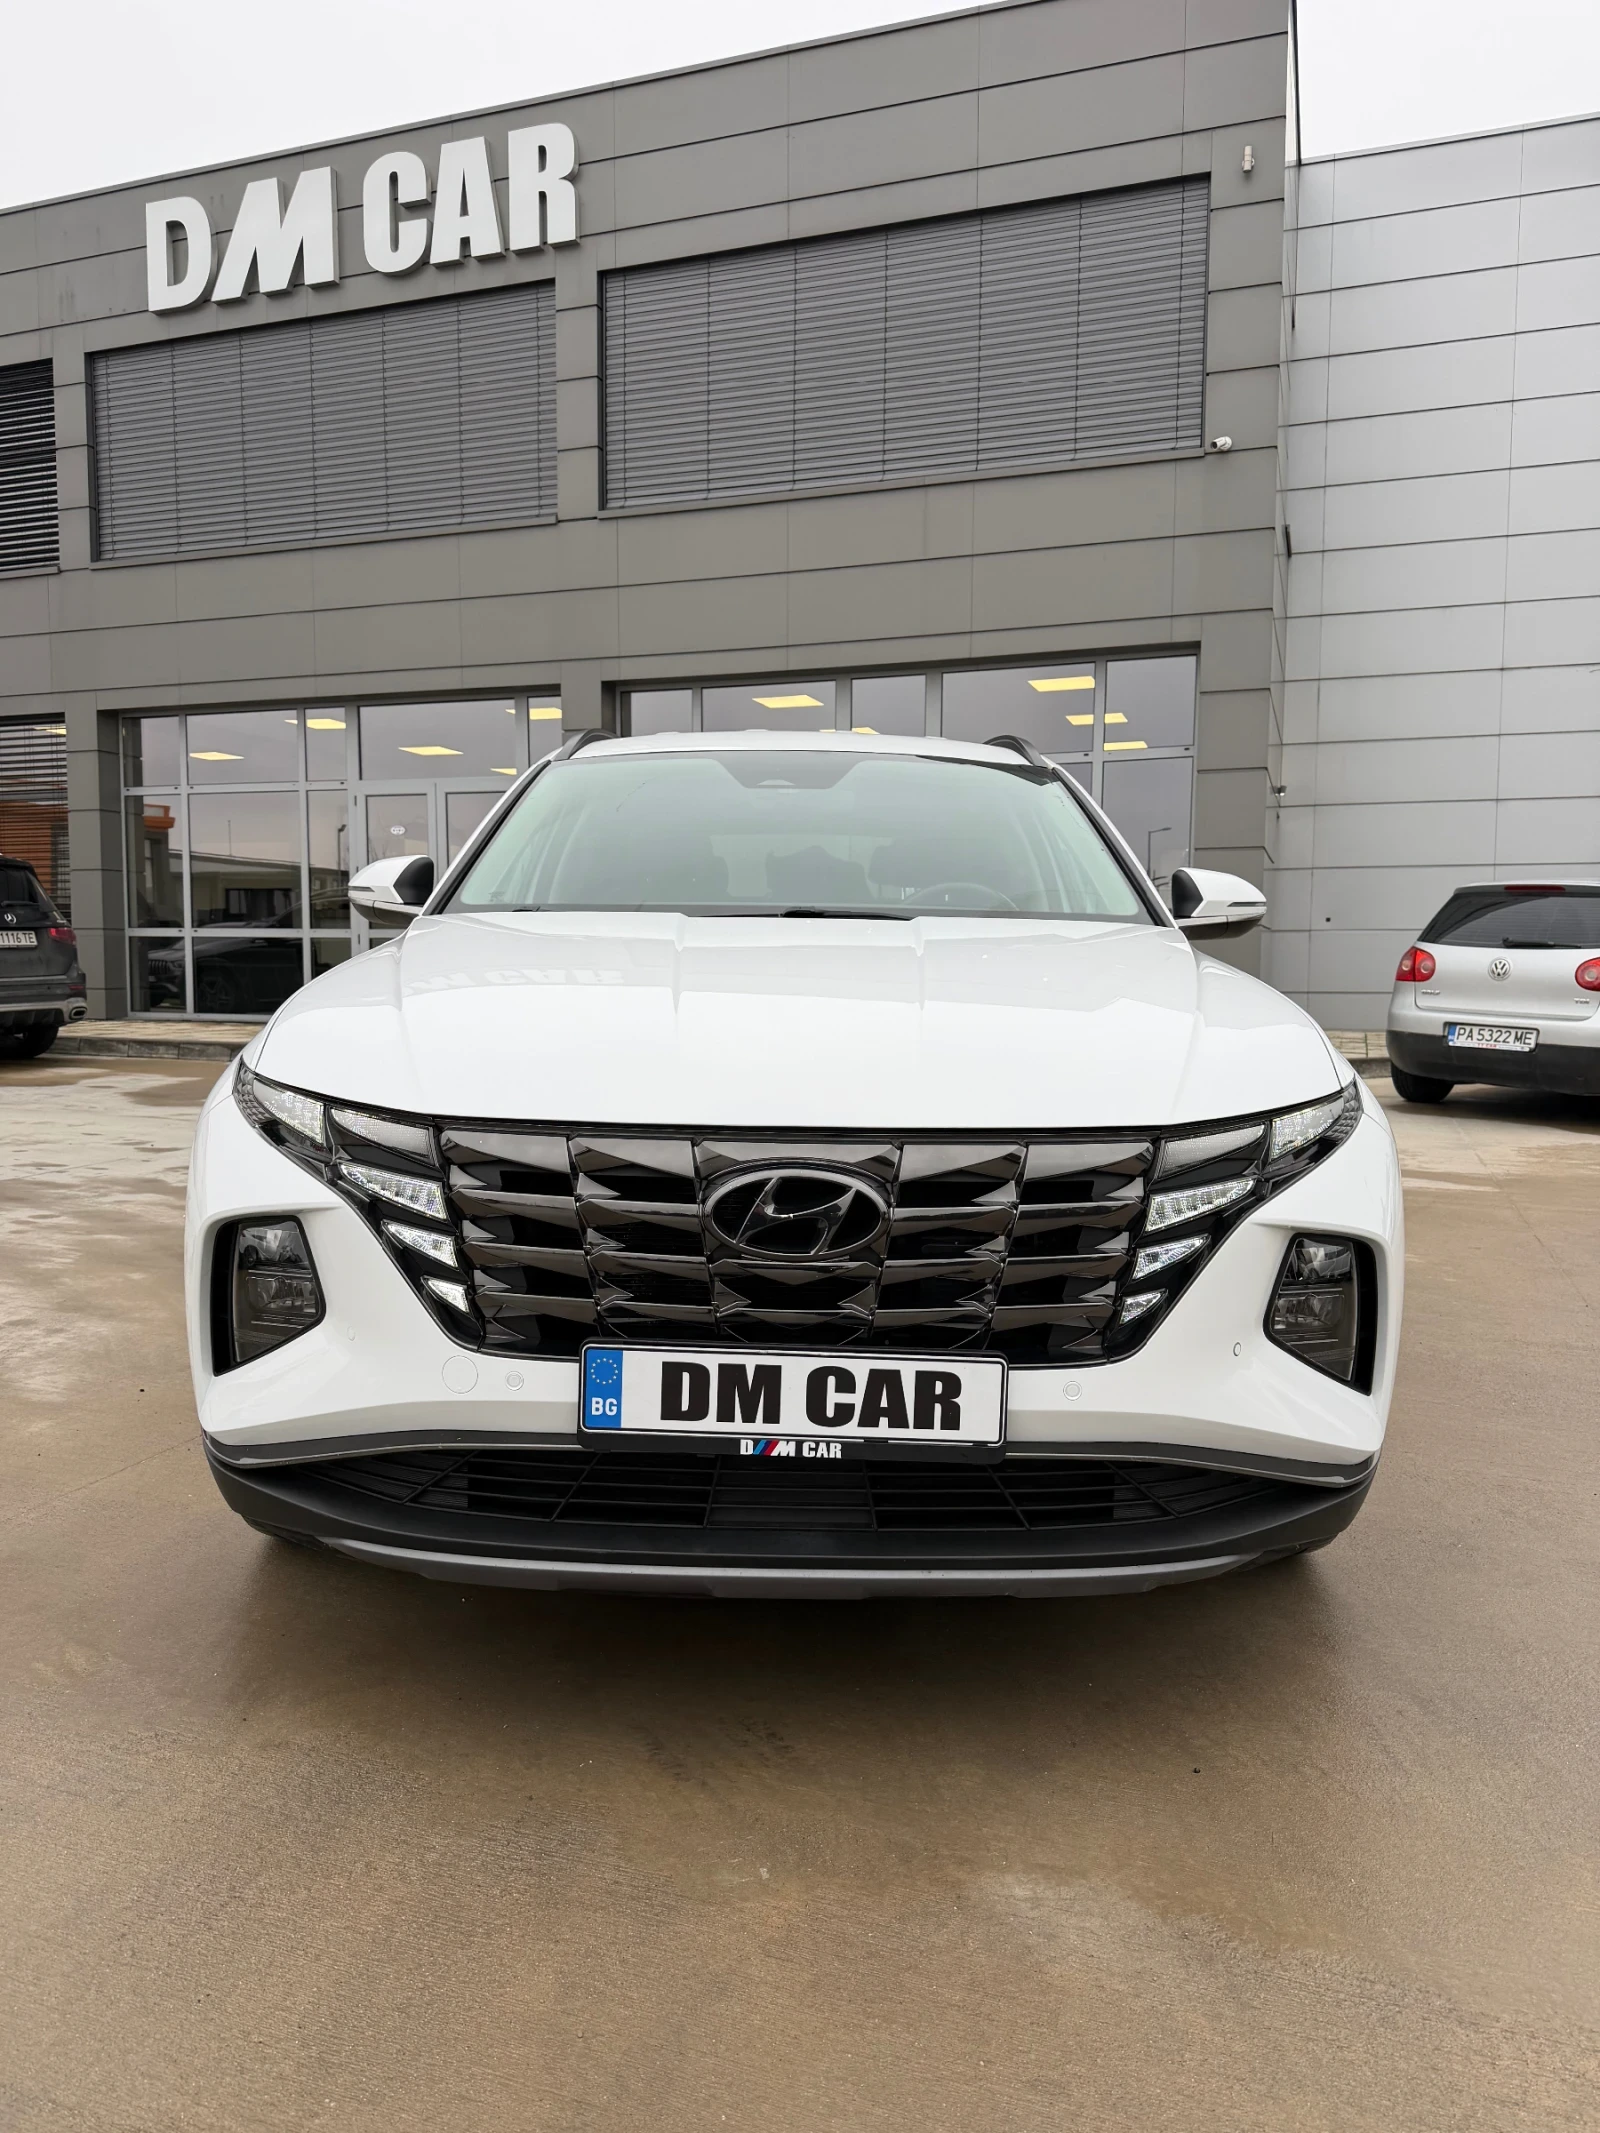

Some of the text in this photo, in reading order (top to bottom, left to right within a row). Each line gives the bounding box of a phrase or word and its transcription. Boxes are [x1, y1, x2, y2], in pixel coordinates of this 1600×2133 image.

[145, 121, 580, 314] DM CAR
[22, 932, 36, 944] TE
[1456, 1027, 1534, 1046] PA 5322 ME
[660, 1360, 963, 1431] DM CAR
[591, 1396, 618, 1416] BG
[802, 1441, 842, 1459] CAR
